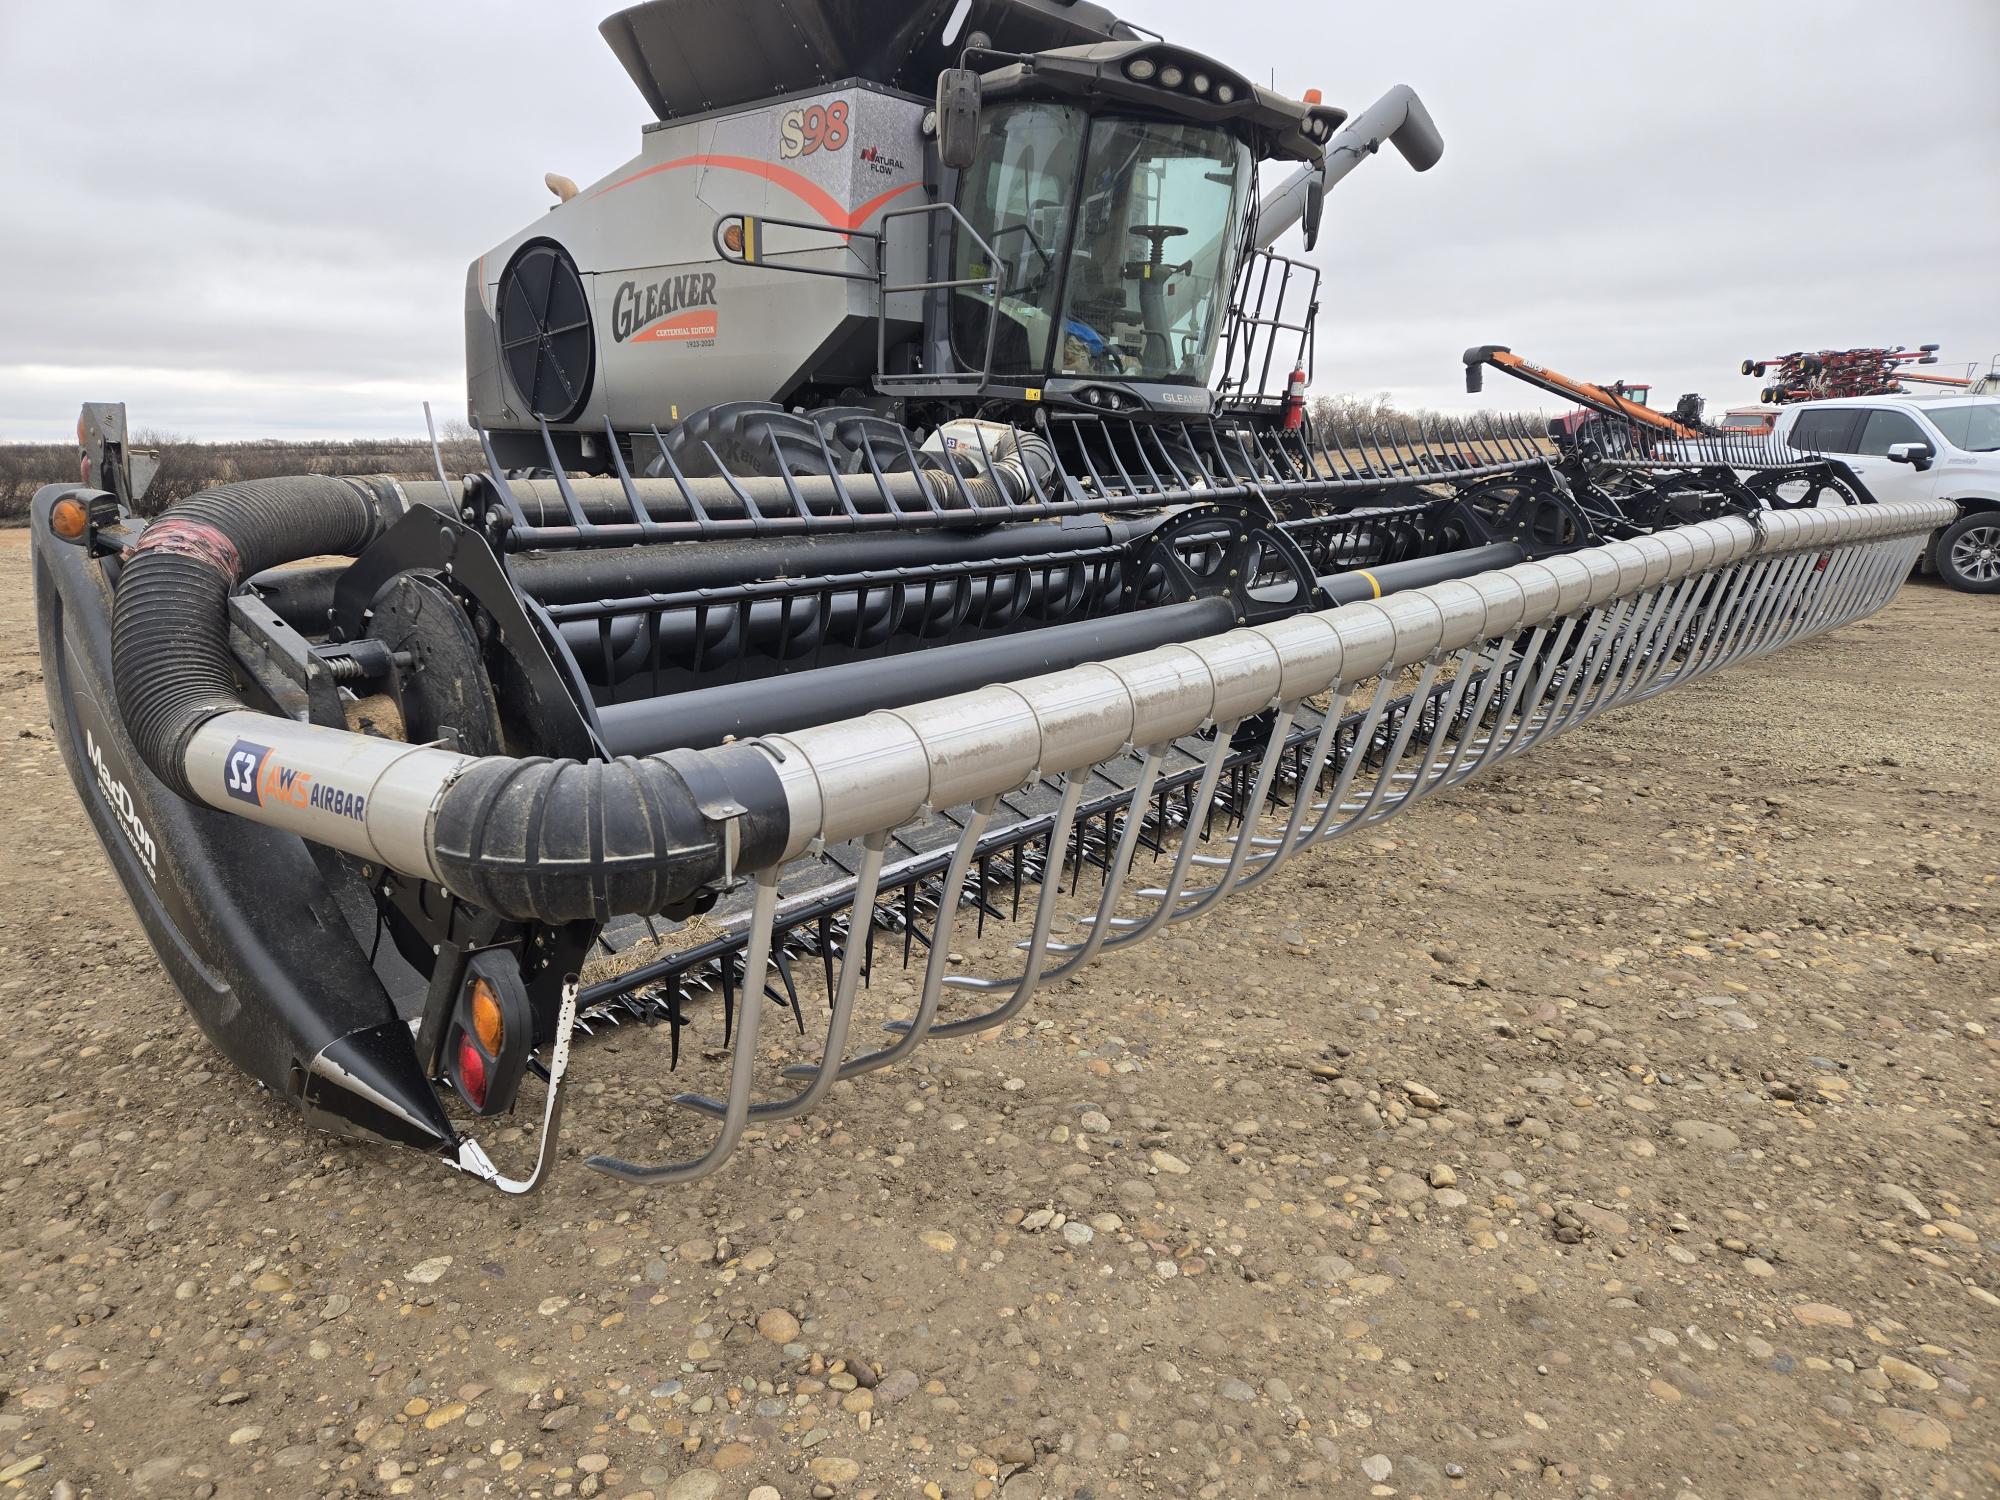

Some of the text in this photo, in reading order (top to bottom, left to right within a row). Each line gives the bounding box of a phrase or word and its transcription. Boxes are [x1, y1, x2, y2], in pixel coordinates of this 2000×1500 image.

[780, 100, 849, 160] S98
[860, 144, 905, 170] NATURAL
[870, 163, 893, 176] FLOW
[611, 272, 717, 343] GLEANER
[655, 326, 715, 337] CENTENNIAL EDITION
[86, 728, 156, 866] MacDon
[229, 751, 364, 822] S3 AWS AIRBAR
